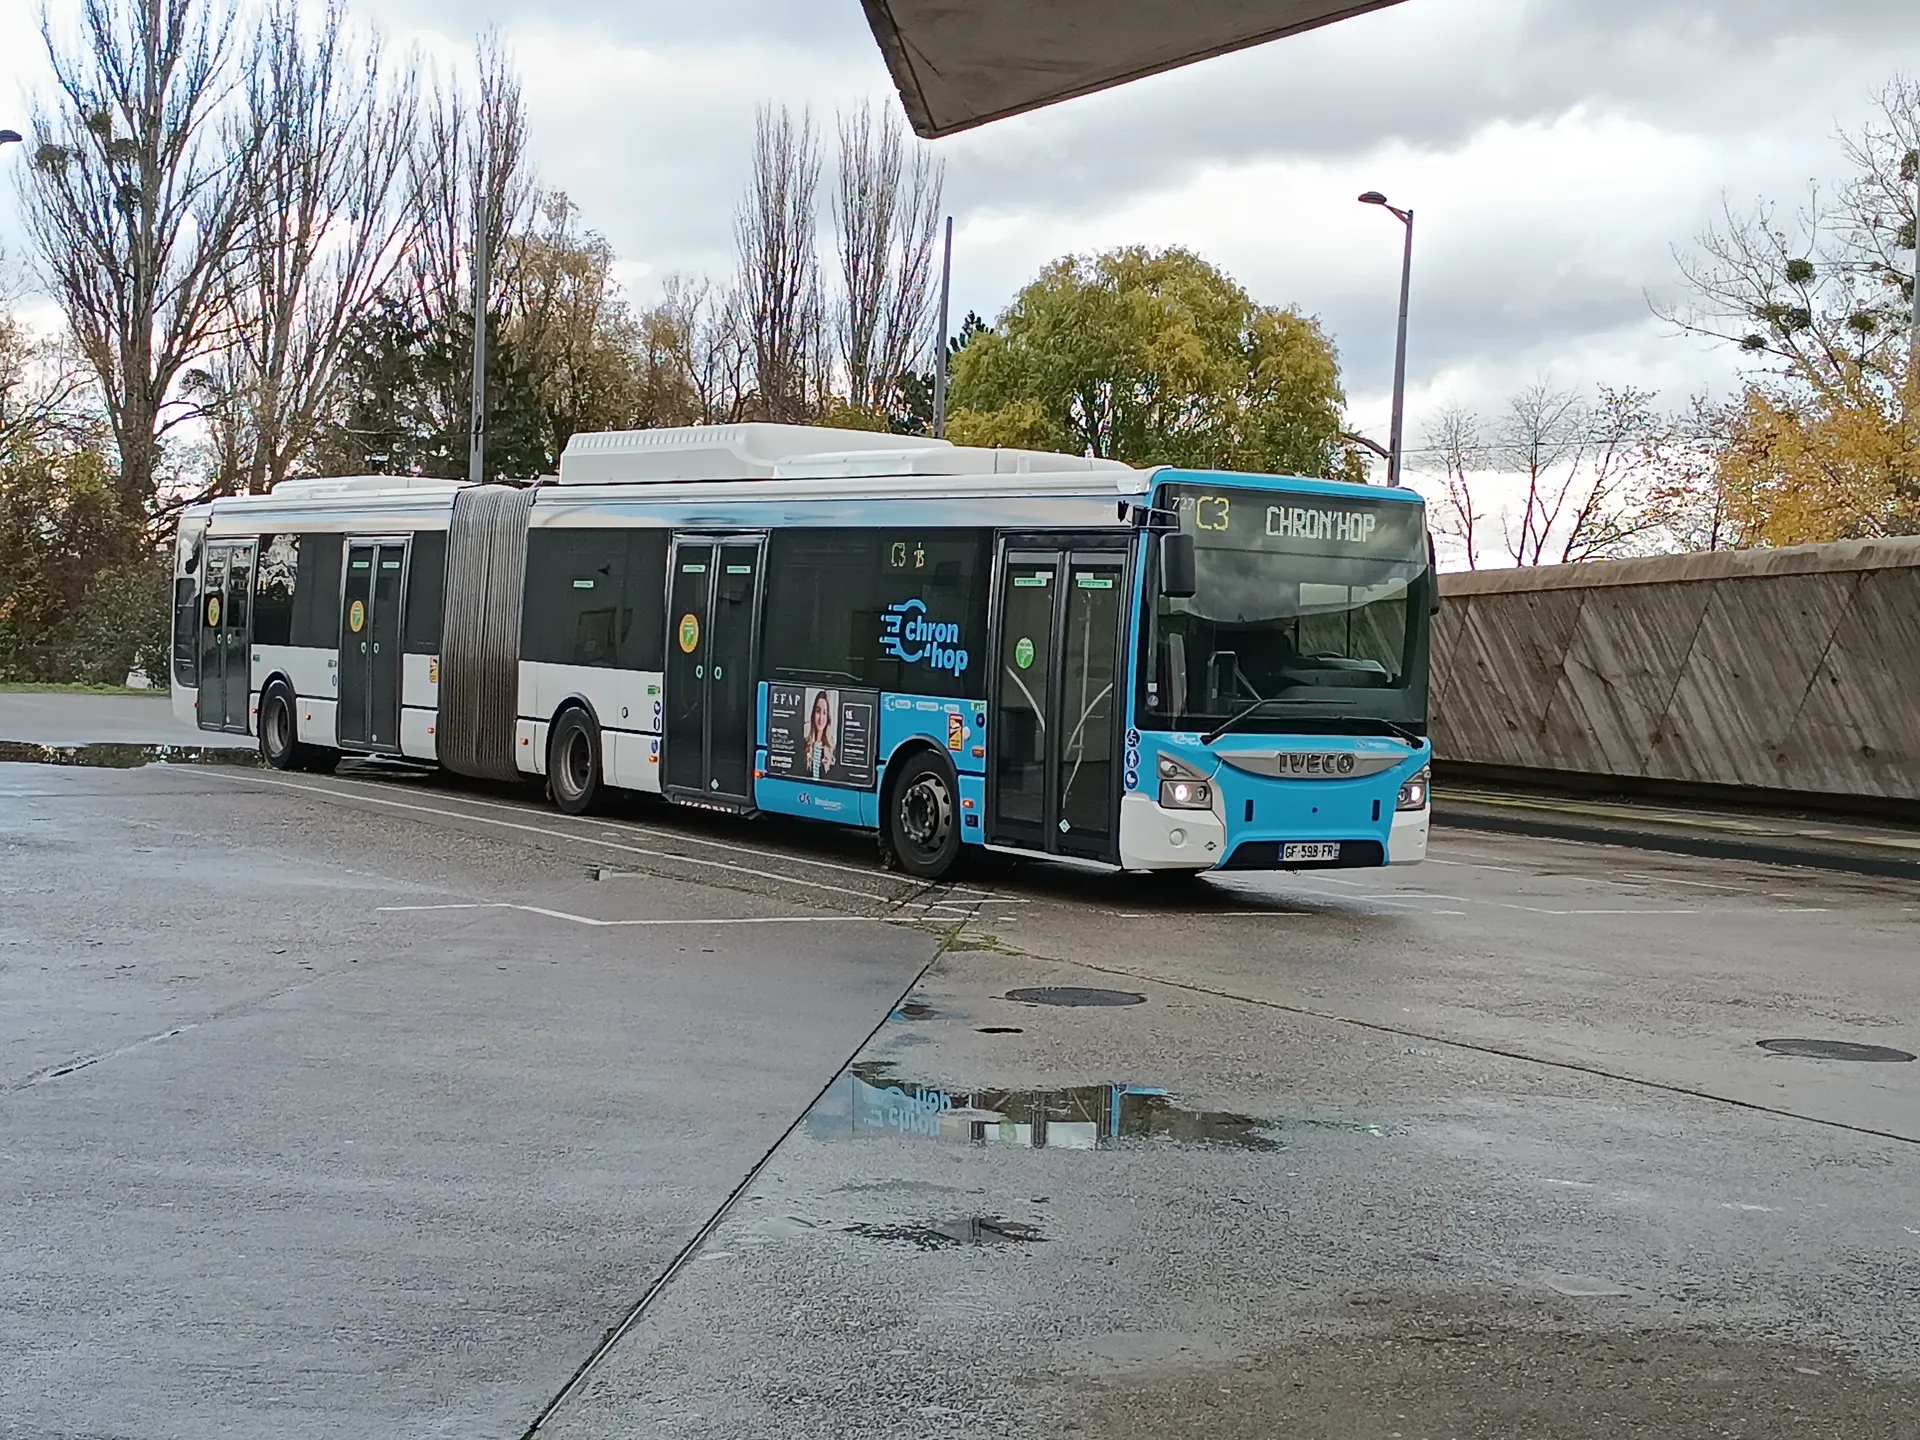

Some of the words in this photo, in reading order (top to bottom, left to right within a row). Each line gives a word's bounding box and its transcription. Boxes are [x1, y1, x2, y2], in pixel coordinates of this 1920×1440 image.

[1172, 496, 1196, 510] 727
[1196, 495, 1230, 531] C3
[1265, 506, 1376, 542] CHRON'HOP
[905, 615, 959, 644] chron
[1279, 752, 1355, 774] IVECO
